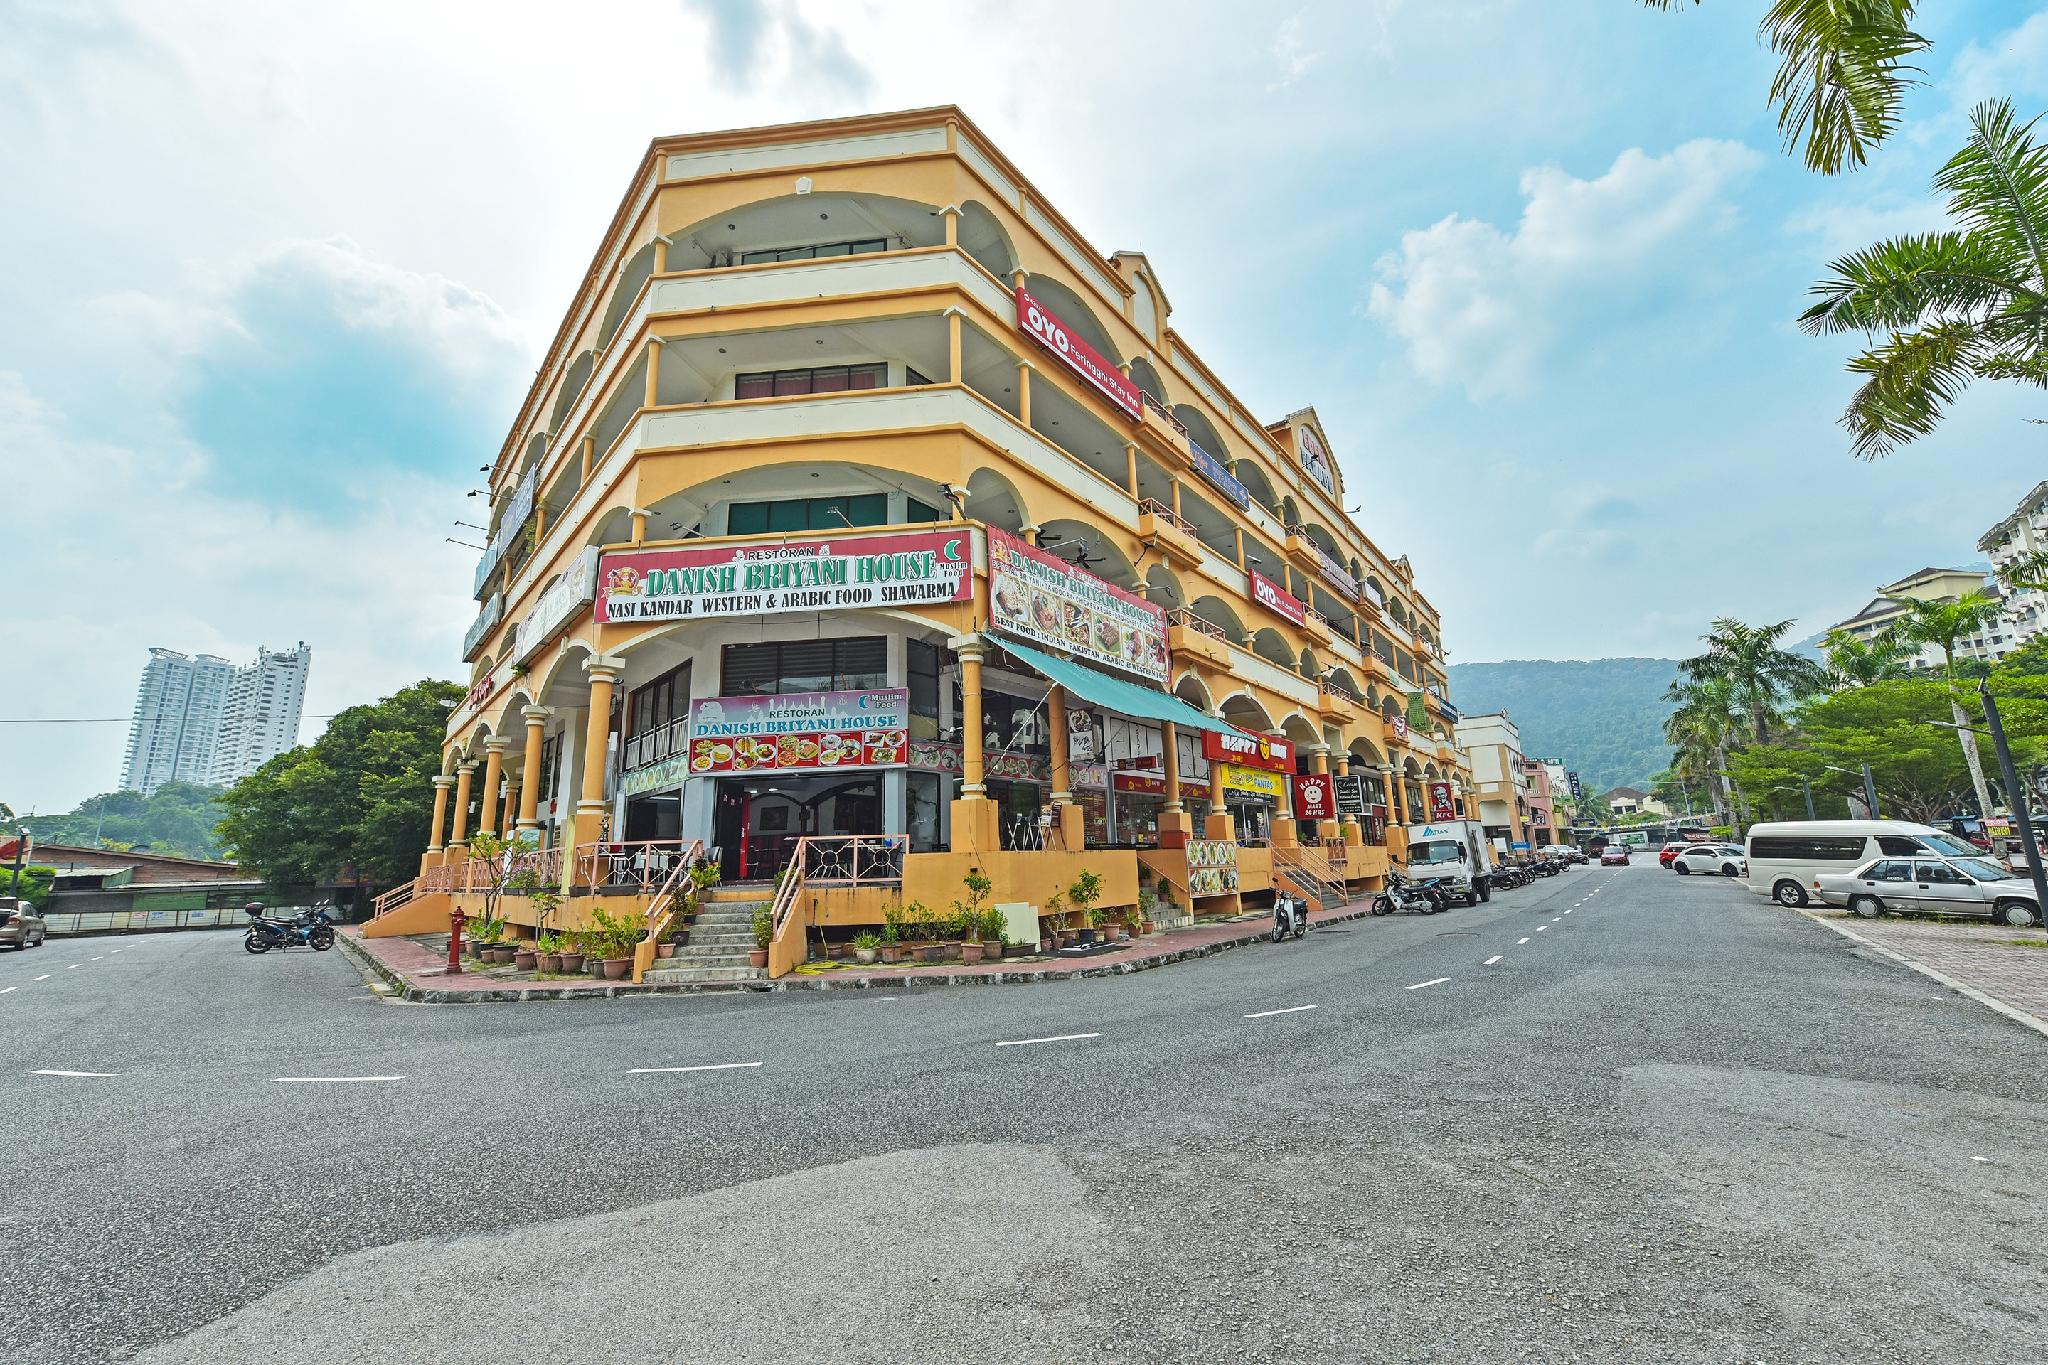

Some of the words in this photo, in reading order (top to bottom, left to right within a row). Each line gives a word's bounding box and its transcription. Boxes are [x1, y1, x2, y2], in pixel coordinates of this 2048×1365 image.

[1028, 306, 1069, 353] OYO
[1070, 343, 1109, 382] Feringghi
[1108, 377, 1126, 399] Stay
[1126, 391, 1139, 408] Inn
[748, 546, 815, 560] RESTORAN
[940, 562, 967, 571] Muslim
[944, 570, 963, 578] Food
[644, 564, 737, 598] DANISH
[744, 558, 847, 592] BRIYANI
[855, 551, 937, 583] HOUSE
[1010, 549, 1066, 588] DANISH
[1067, 577, 1119, 613] BRIYANI
[1257, 578, 1276, 605] OYO
[608, 602, 636, 618] NASI
[640, 599, 693, 617] KANDAR
[702, 594, 761, 612] WESTERN
[766, 593, 777, 608] &
[781, 590, 831, 608] ARABIC
[835, 588, 873, 604] FOOD
[881, 581, 956, 601] SHAWARMA
[1015, 622, 1035, 637] FOOD
[871, 693, 902, 701] Muslim
[769, 708, 825, 720] RESTORAN
[696, 721, 761, 736] DANISH
[766, 718, 836, 733] BRIYANI
[840, 715, 898, 729] HOUSE
[1299, 777, 1326, 790] HAPPY
